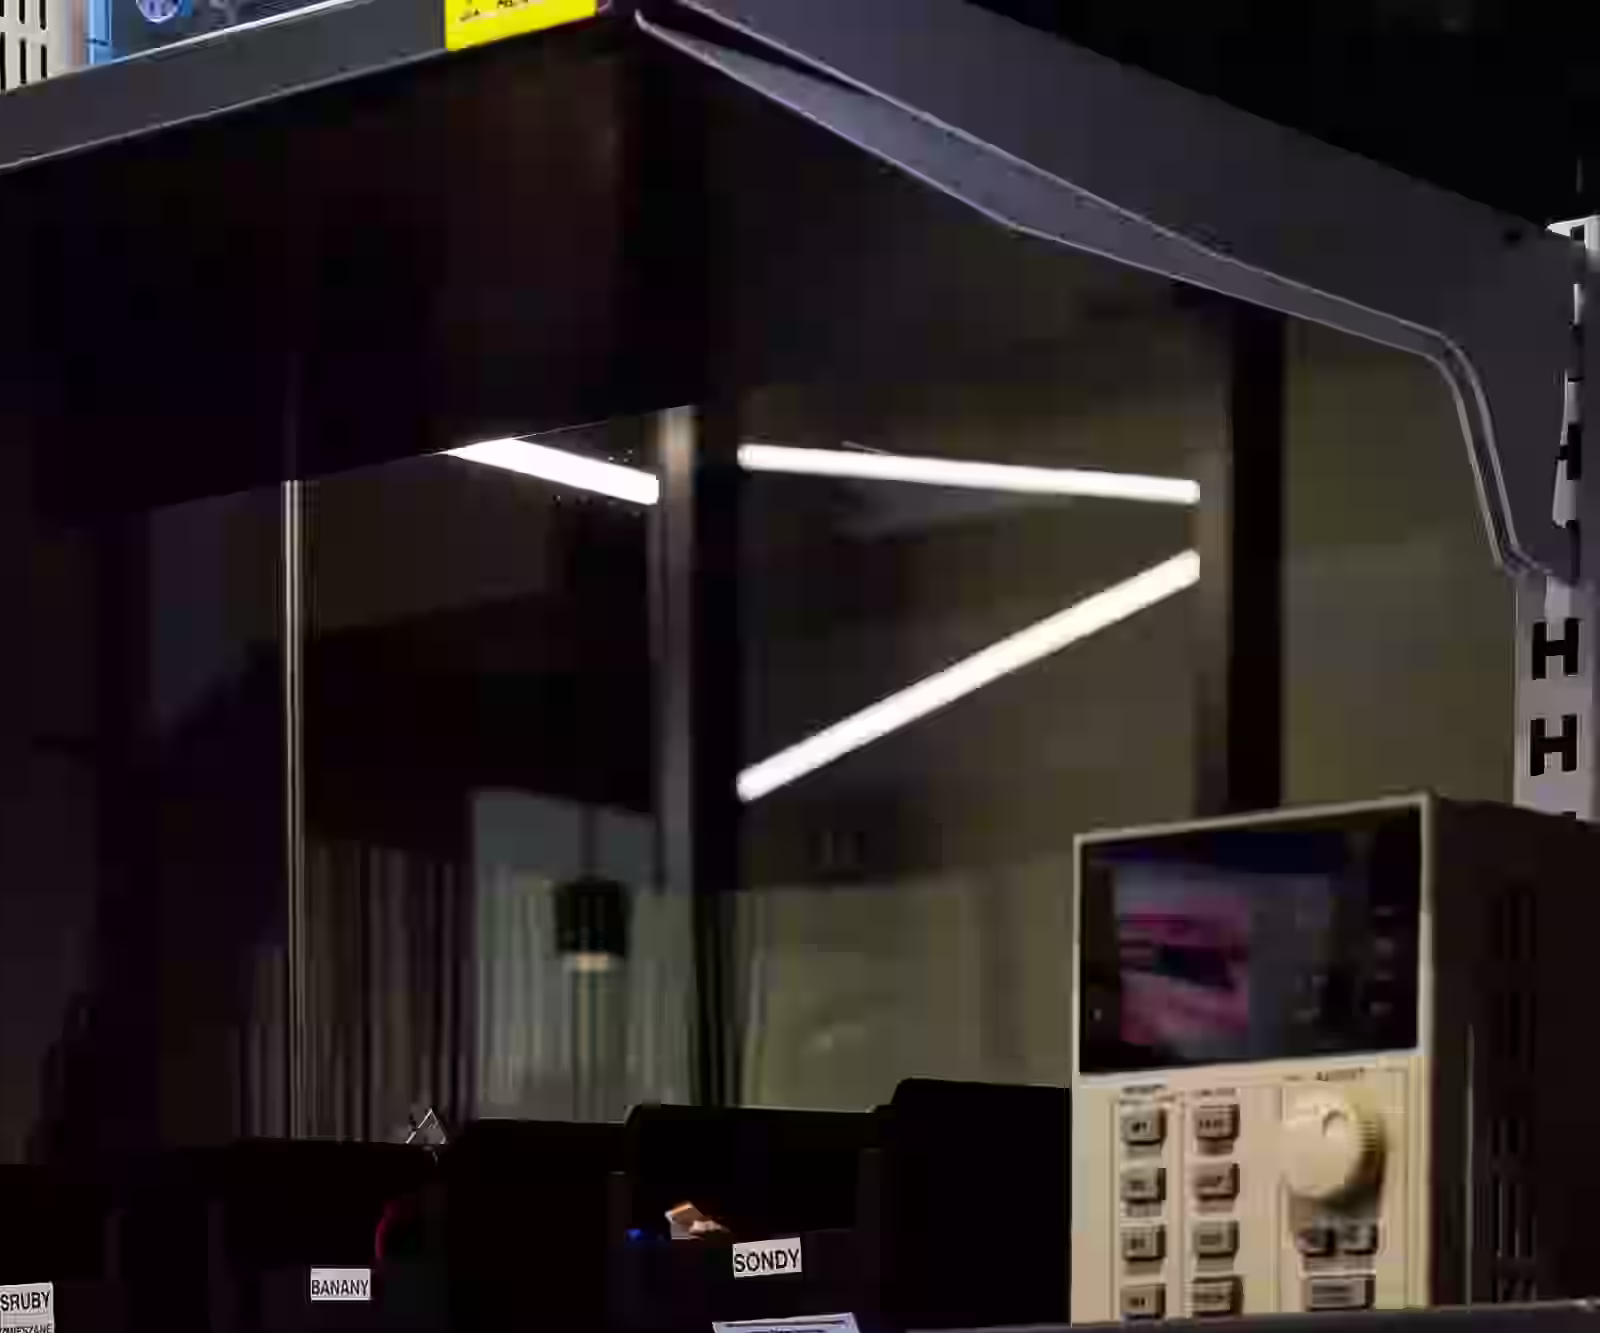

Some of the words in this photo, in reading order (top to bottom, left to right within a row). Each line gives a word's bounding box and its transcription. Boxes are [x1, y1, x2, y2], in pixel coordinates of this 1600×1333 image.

[733, 1247, 800, 1273] SONDY
[310, 1278, 369, 1297] BANANY
[0, 1290, 51, 1312] SRUBY
